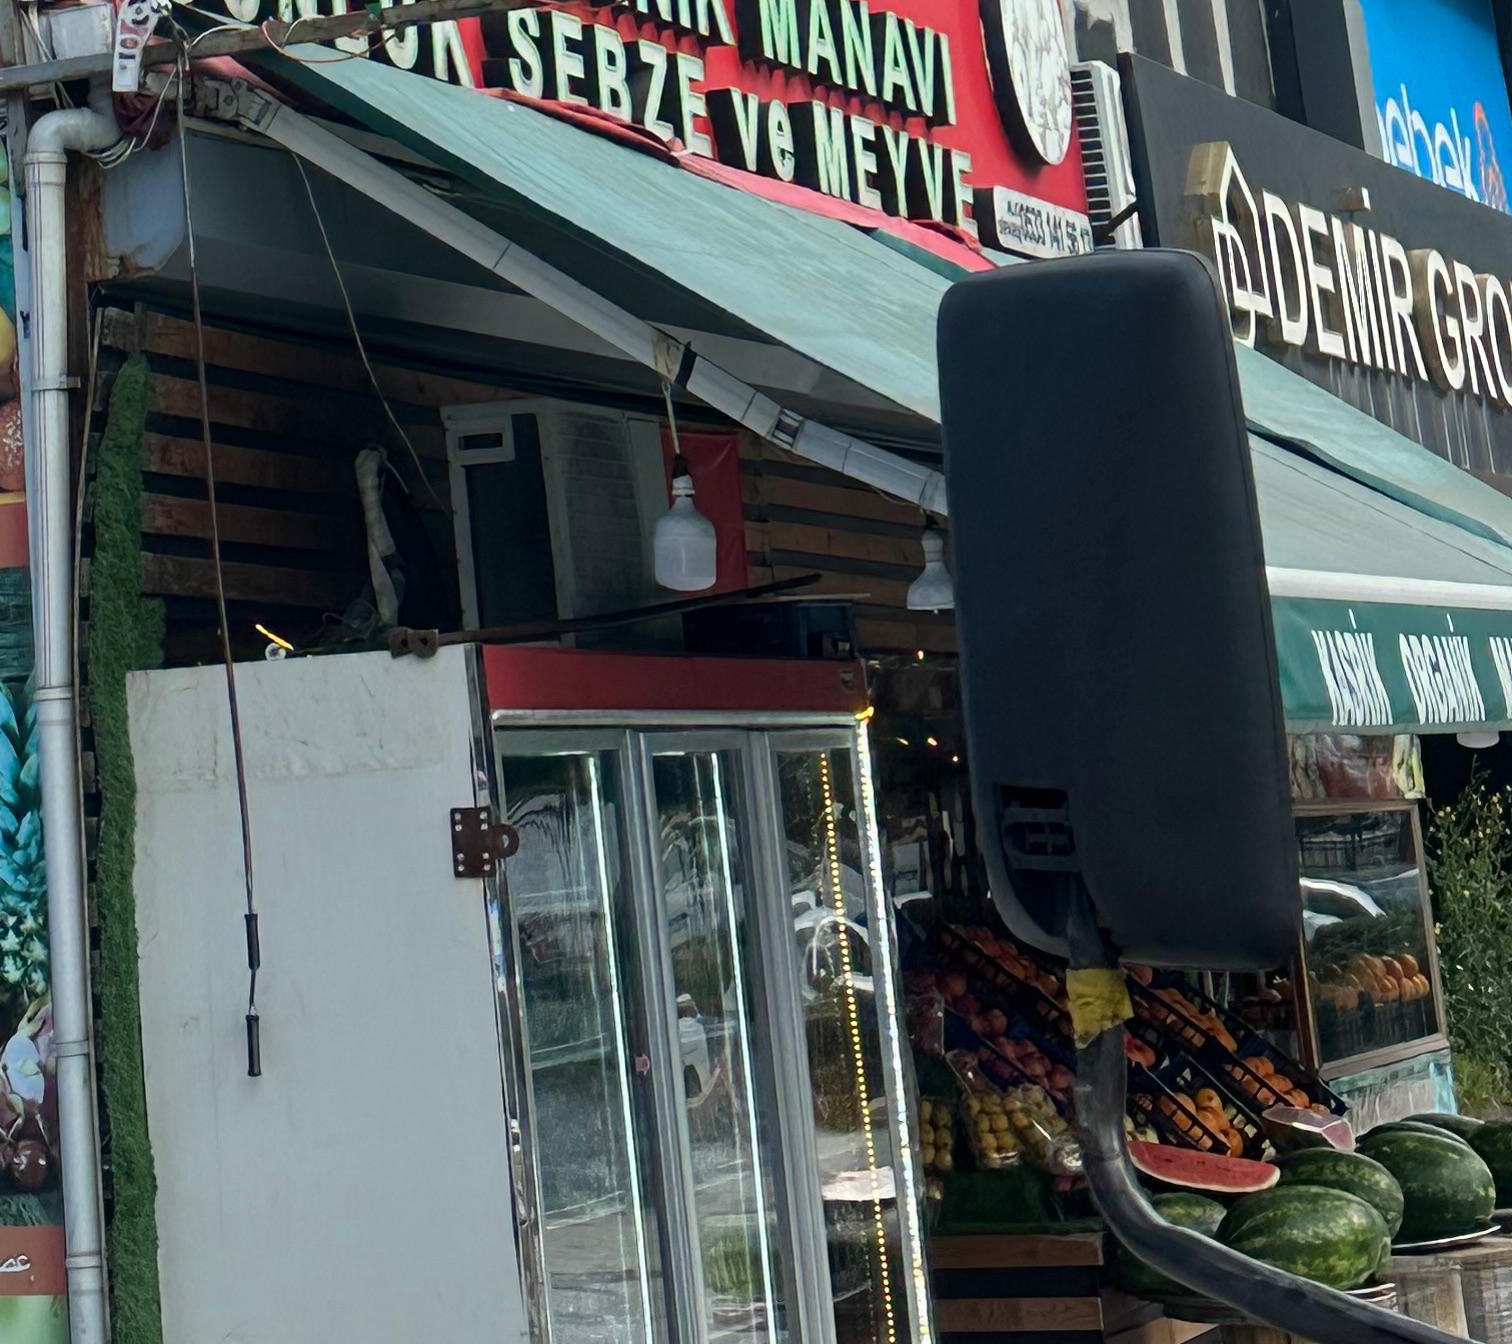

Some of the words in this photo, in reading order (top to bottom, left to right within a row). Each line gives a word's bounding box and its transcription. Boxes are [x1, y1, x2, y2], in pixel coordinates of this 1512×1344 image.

[508, 8, 712, 158] SEBZE
[813, 100, 978, 237] MEYVE
[1263, 188, 1428, 380] DEMİR
[1427, 249, 1512, 408] GRO
